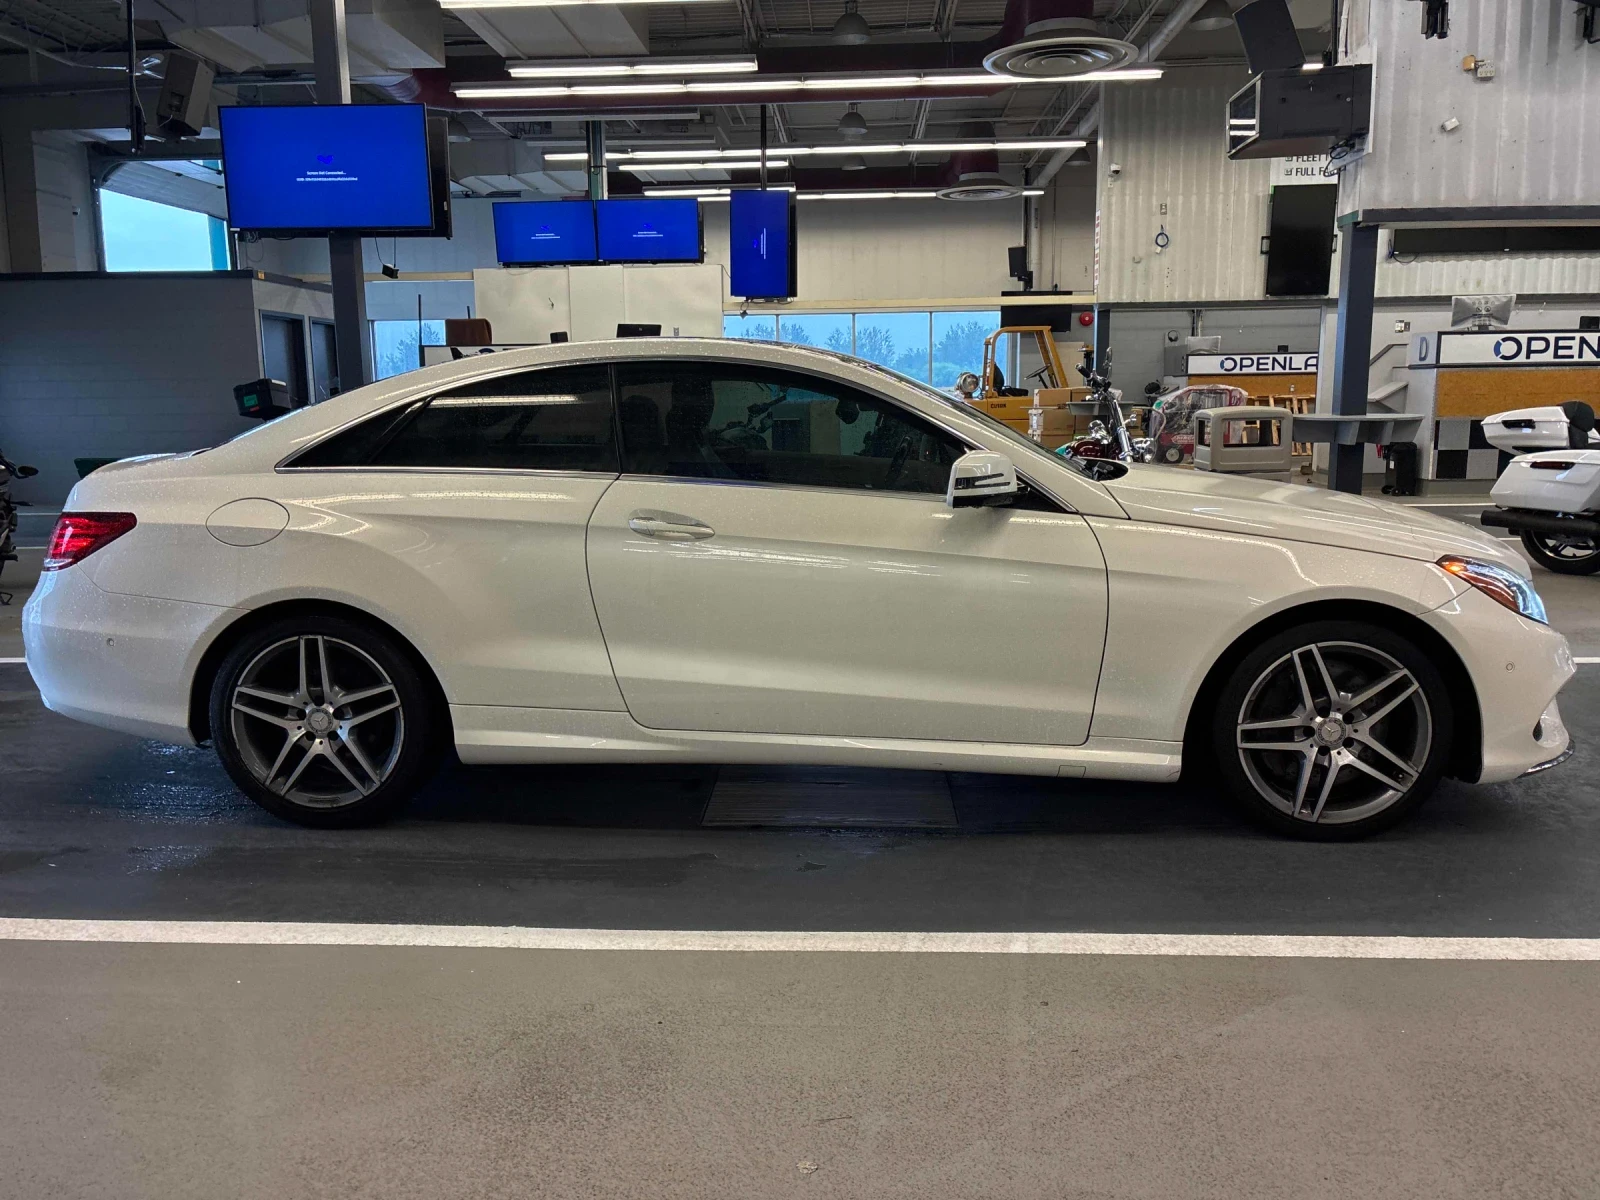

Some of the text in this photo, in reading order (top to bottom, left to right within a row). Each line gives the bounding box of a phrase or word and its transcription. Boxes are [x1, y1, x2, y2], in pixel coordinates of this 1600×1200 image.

[1295, 167, 1316, 176] FULL
[1418, 336, 1430, 362] D
[1493, 336, 1600, 361] OPEN
